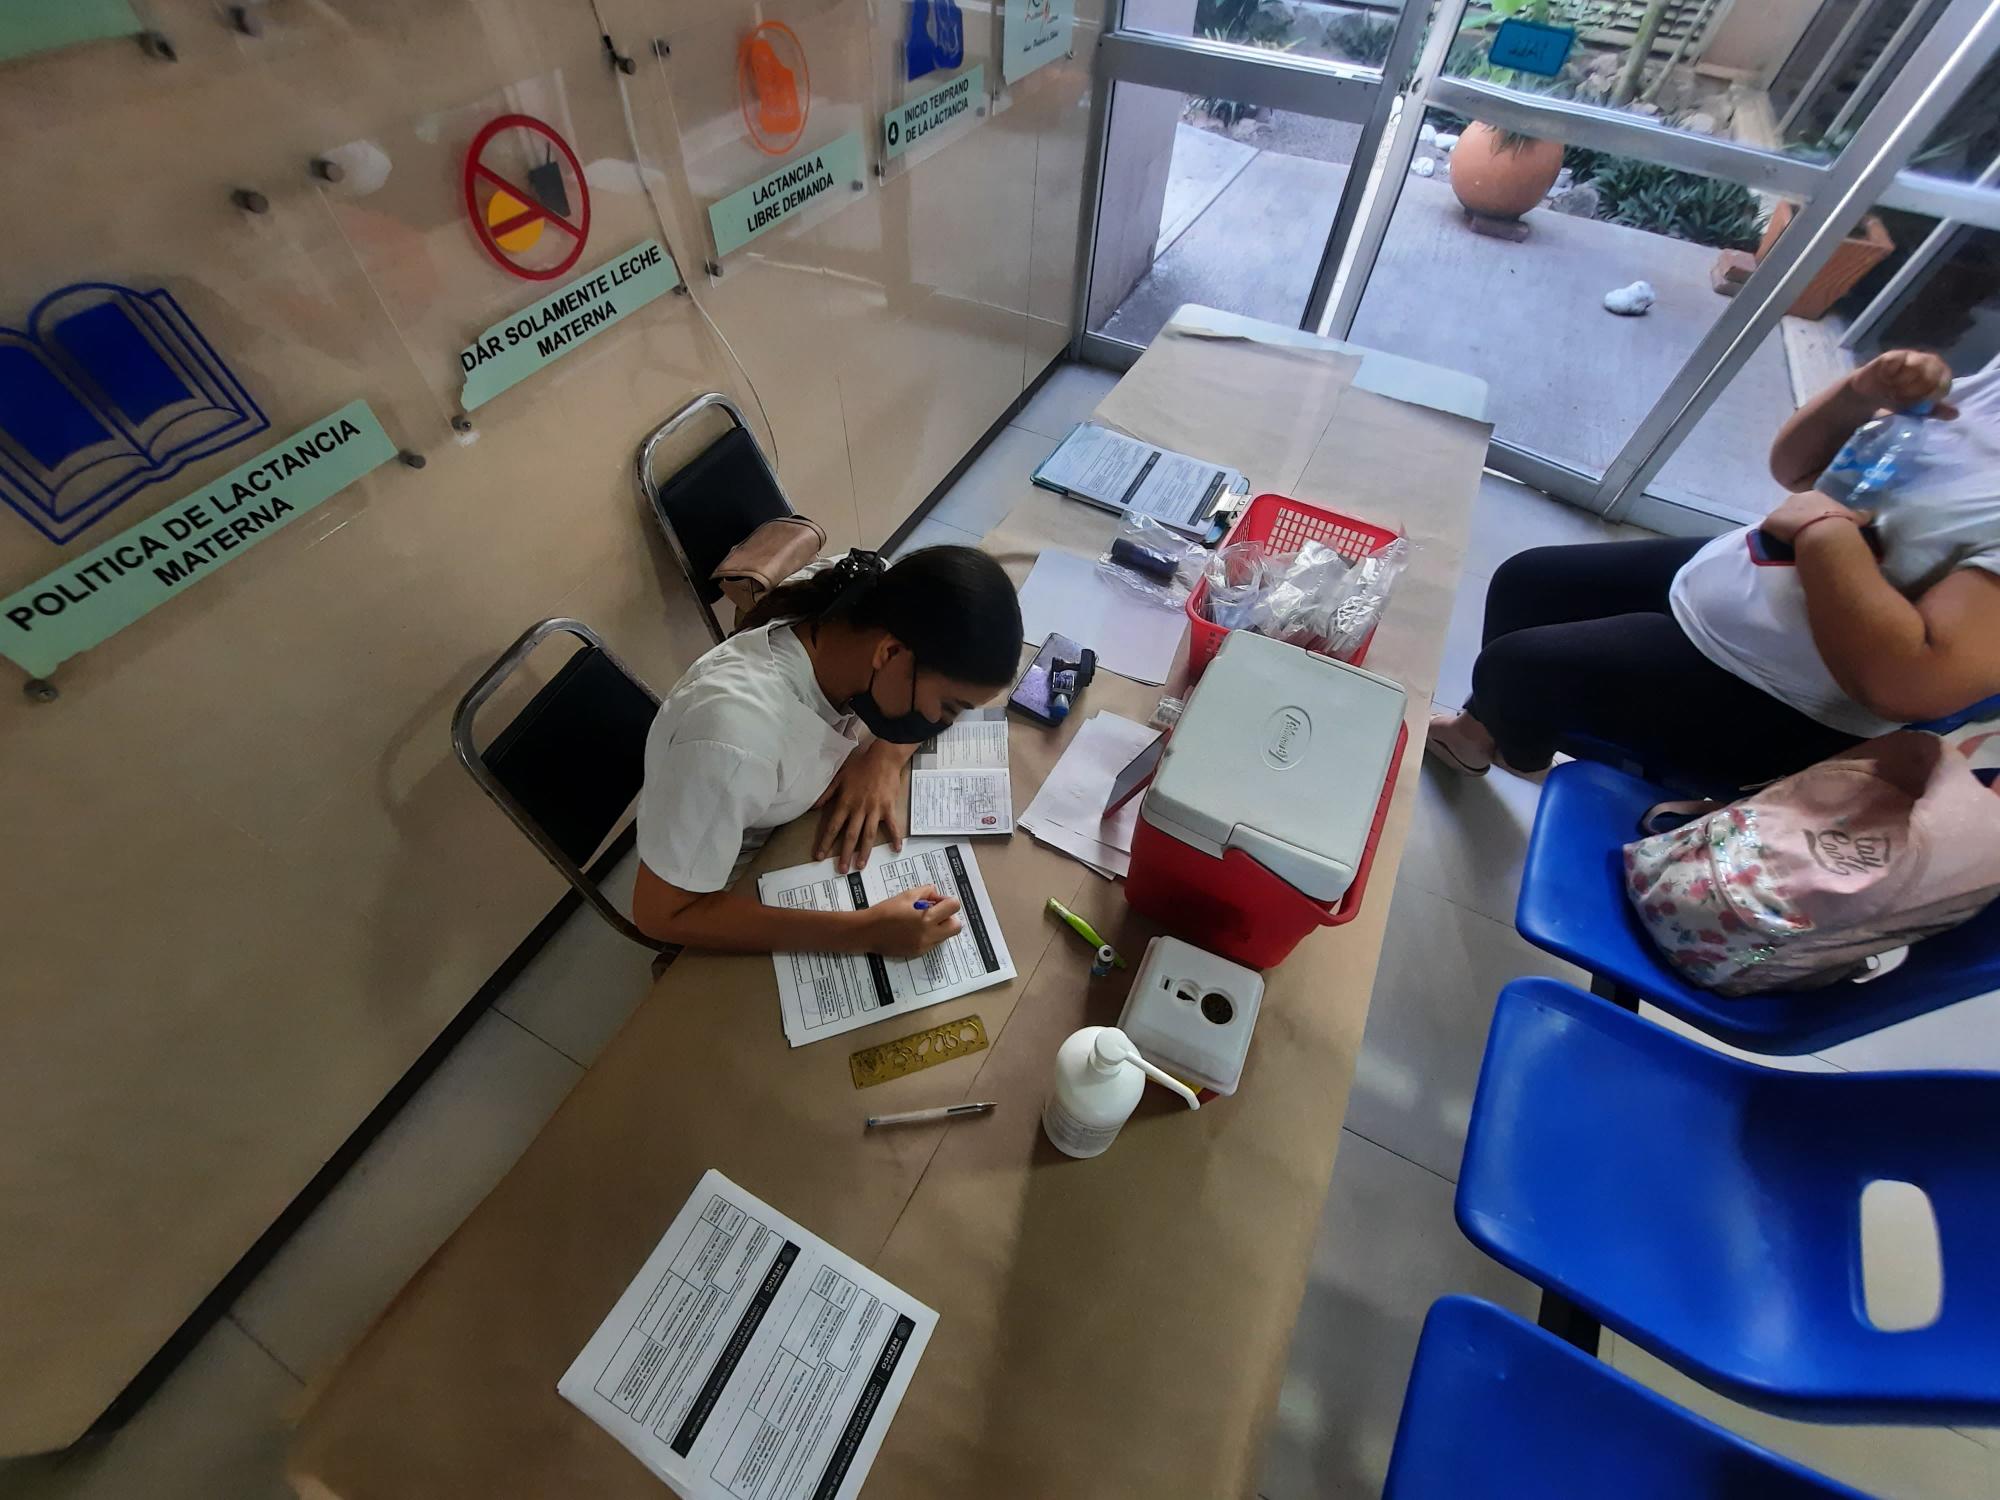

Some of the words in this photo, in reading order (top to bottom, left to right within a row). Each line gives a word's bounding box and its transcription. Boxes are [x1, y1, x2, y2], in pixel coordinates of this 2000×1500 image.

[905, 101, 928, 124] INICIO
[929, 79, 968, 108] TEMPRANO
[906, 128, 916, 144] DE
[919, 121, 928, 136] LA
[930, 98, 968, 130] LACTANCIA
[747, 202, 781, 232] LIBRE
[783, 173, 834, 213] DEMANDA
[753, 161, 814, 206] LACTANCIA
[816, 156, 823, 172] A
[461, 335, 505, 373] DAR
[504, 282, 609, 348] SOLAMENTE
[610, 246, 662, 286] LECHE
[536, 300, 618, 359] MATERNA
[4, 531, 169, 633] POLITICA
[162, 503, 213, 543] DE
[210, 418, 361, 514] LACTANCIA
[153, 496, 295, 588] MATERNA
[878, 1336, 901, 1370] MÉXICO
